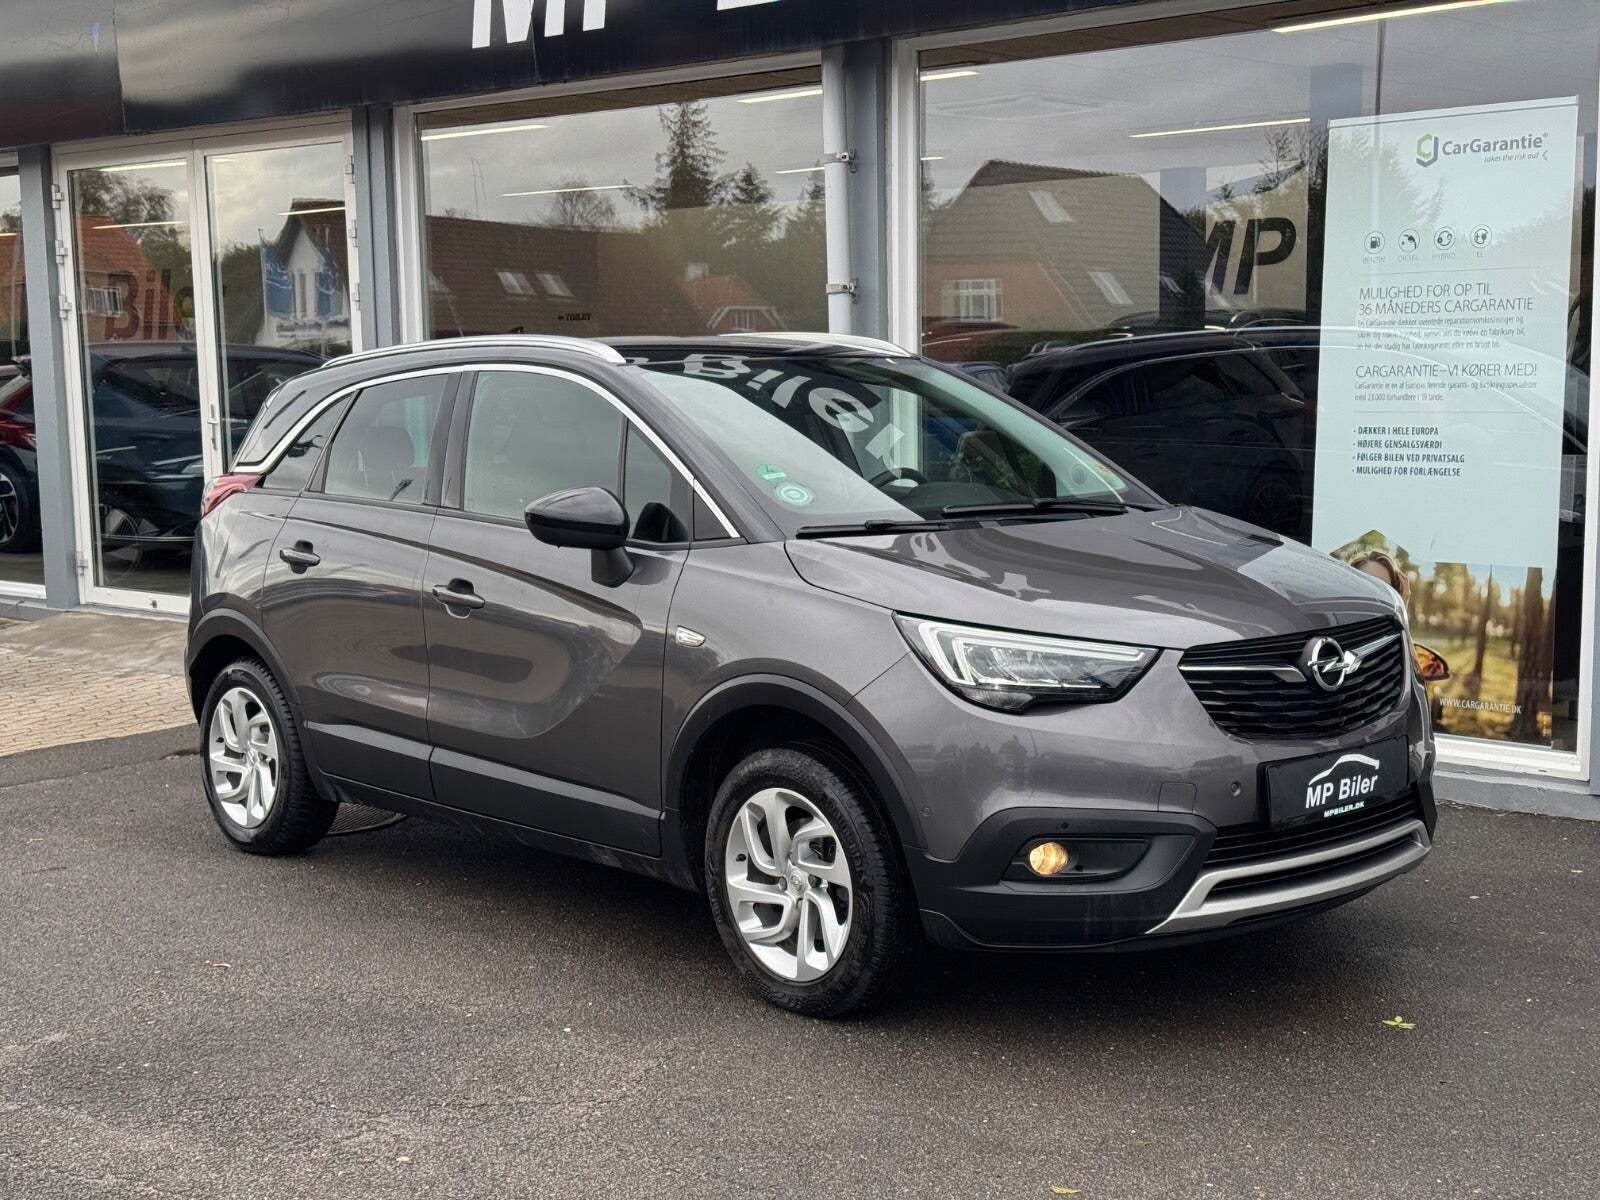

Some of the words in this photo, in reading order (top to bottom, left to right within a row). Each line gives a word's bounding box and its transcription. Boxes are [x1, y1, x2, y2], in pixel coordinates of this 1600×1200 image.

[1359, 285, 1423, 300] MULIGHED
[1427, 284, 1450, 298] FOR
[1454, 283, 1473, 297] OP
[1476, 282, 1493, 296] TIL
[1359, 303, 1373, 316] 36
[1375, 299, 1441, 315] MÅNEDERS
[1444, 297, 1534, 313] CARGARANTIE
[1462, 363, 1500, 377] KØRER
[1504, 362, 1537, 376] MED!
[1358, 426, 1386, 435] DÆKKER
[1392, 426, 1410, 435] HELE
[1411, 427, 1439, 435] EUROPA
[1357, 439, 1382, 449] HØJERE
[1384, 440, 1443, 449] GENSALGSVÆRDI
[1356, 452, 1382, 462] FØLGER
[1384, 453, 1404, 462] BILEN
[1406, 454, 1420, 462] VED
[1421, 454, 1465, 463] PRIVATSALG
[1355, 465, 1392, 475] MULIGHED
[1394, 466, 1408, 475] FOR
[1409, 467, 1461, 477] FORLÆNGELSE
[1440, 697, 1522, 714] WWW.CARGARANTIE.DK
[1305, 782, 1335, 809] MP
[1338, 774, 1379, 800] Biler
[1323, 801, 1365, 818] MPBILER.DK
